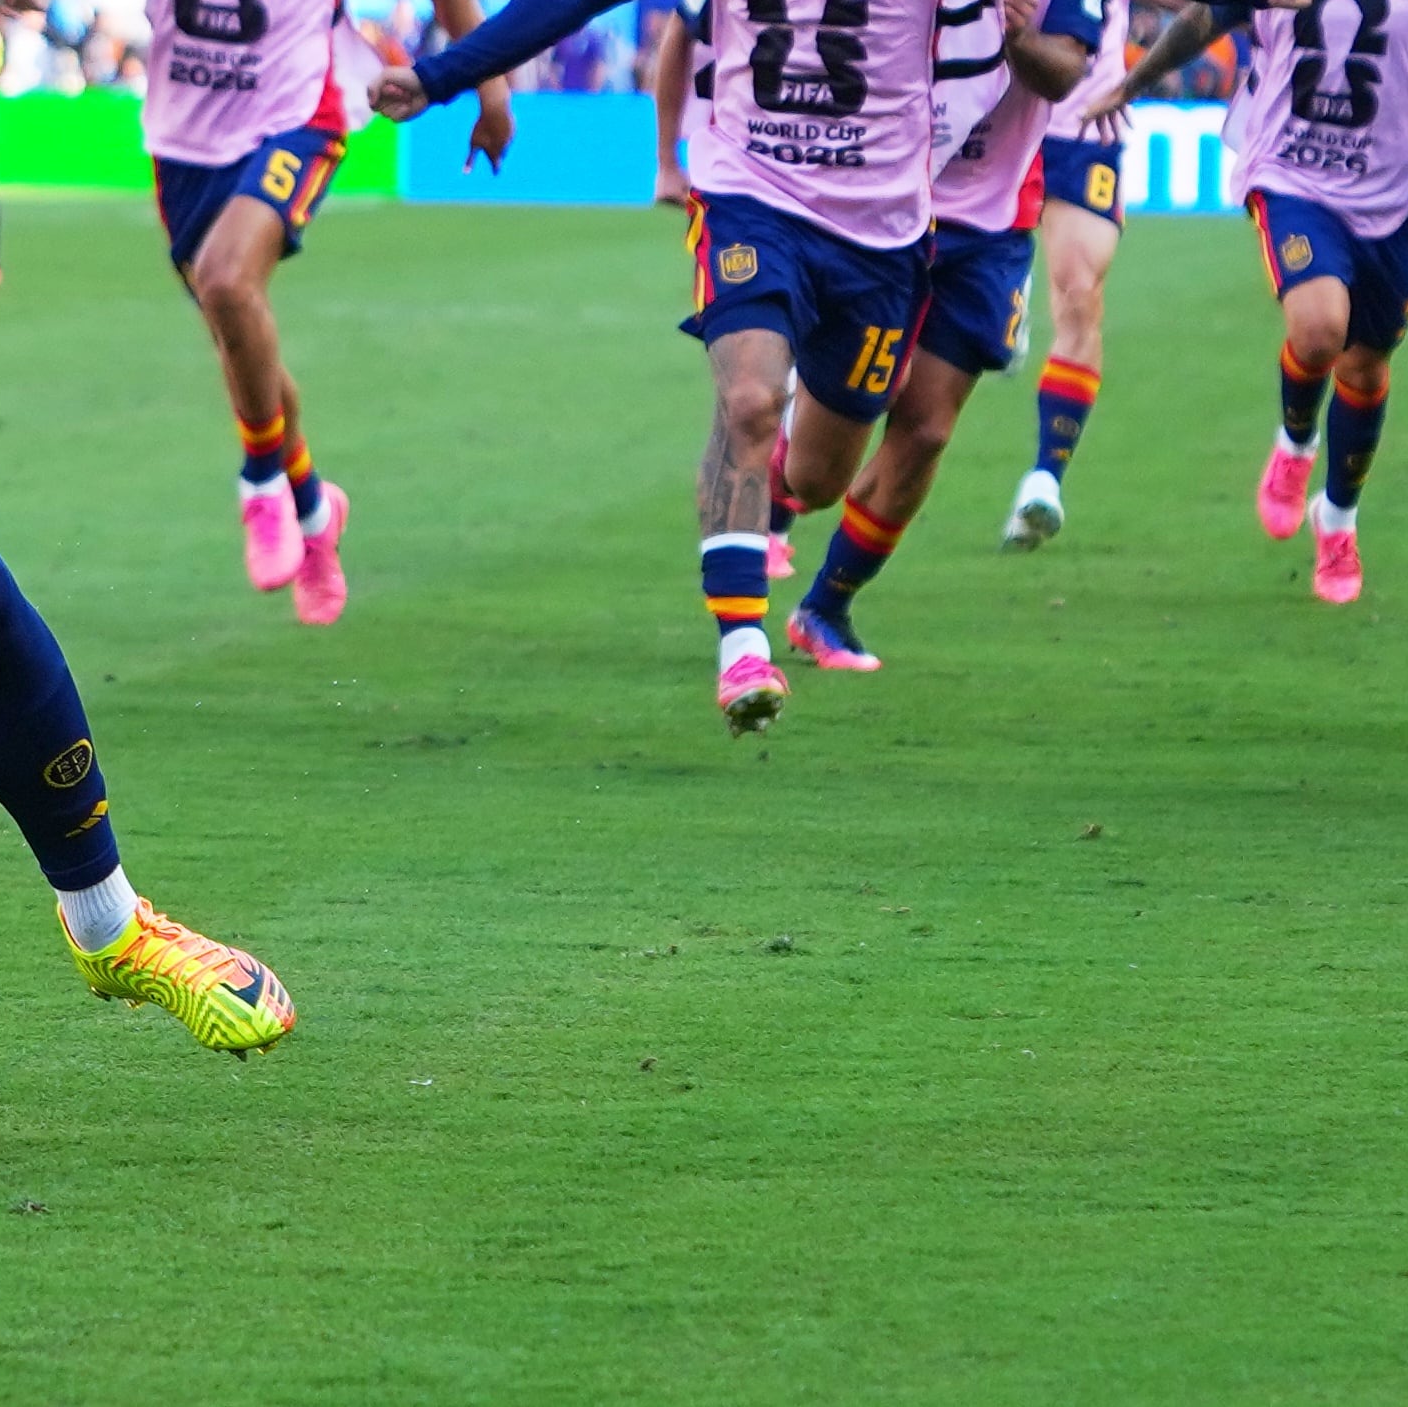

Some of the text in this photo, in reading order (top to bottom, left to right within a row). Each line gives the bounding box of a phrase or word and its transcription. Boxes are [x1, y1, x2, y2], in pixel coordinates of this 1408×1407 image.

[779, 80, 834, 105] FIFA
[747, 119, 867, 141] WORLD CUP
[746, 139, 866, 167] 2026
[261, 148, 303, 202] 6
[1088, 163, 1116, 210] 8
[846, 325, 905, 394] 15
